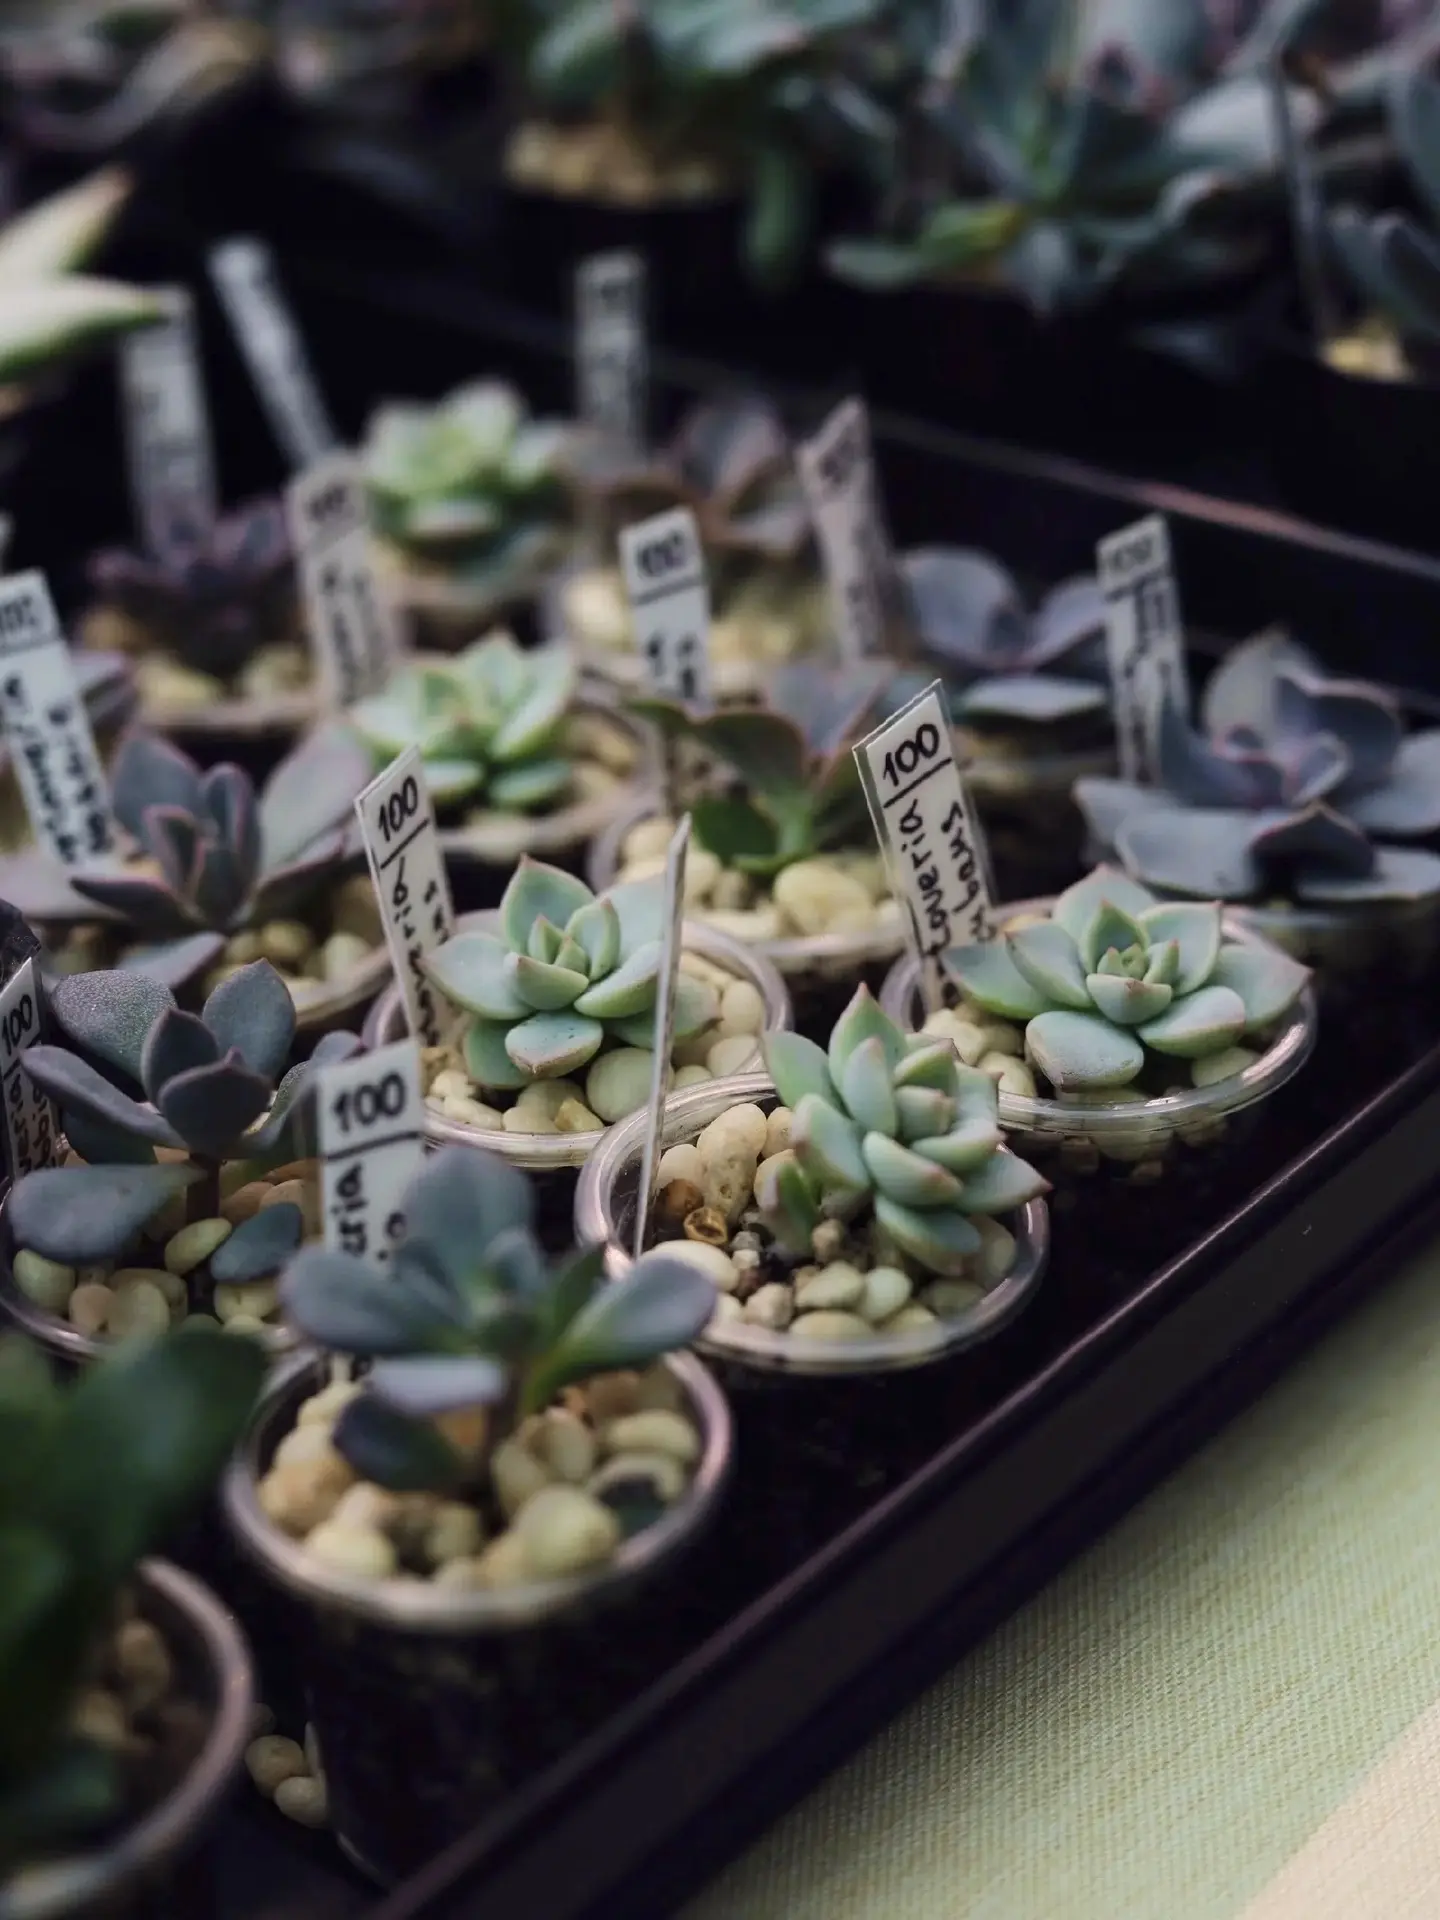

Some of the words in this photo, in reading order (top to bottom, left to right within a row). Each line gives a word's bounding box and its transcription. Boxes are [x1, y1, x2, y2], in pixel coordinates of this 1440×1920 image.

[883, 723, 940, 787] 100
[378, 775, 418, 842] 100
[1, 994, 32, 1056] 100
[331, 1072, 406, 1133] 100
